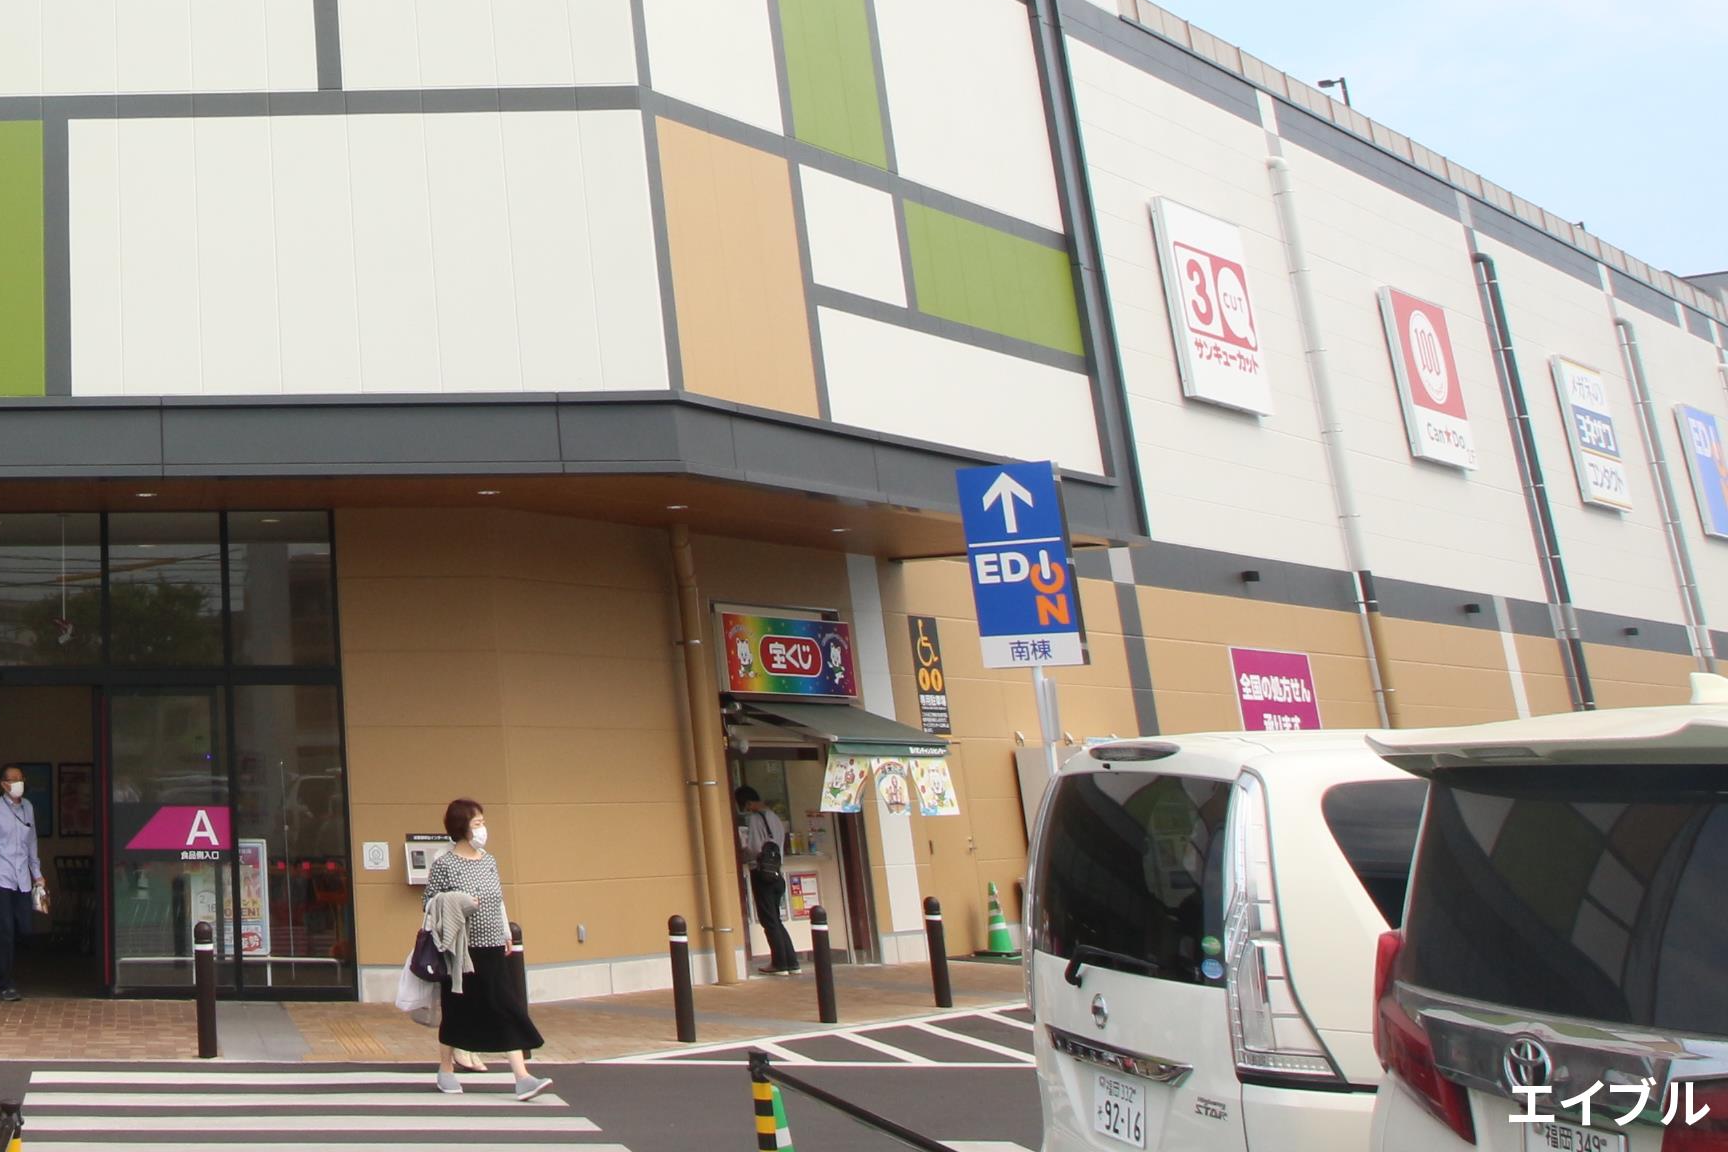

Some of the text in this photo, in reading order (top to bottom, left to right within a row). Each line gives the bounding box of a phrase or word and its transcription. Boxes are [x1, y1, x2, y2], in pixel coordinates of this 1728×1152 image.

[1223, 292, 1245, 313] CUT
[1194, 338, 1259, 375] サンキューカット
[1576, 413, 1617, 452] ヨネザワ
[1589, 461, 1624, 493] コンタクト
[975, 549, 1071, 626] EDION
[768, 641, 813, 671] 宝くじ
[1009, 639, 1052, 662] 南棟
[1239, 672, 1312, 703] 全国の処方せん
[186, 809, 220, 846] A
[180, 850, 220, 861] 食品側入口
[1104, 1099, 1141, 1142] 92-16
[1544, 1124, 1601, 1152] 福岡 349
